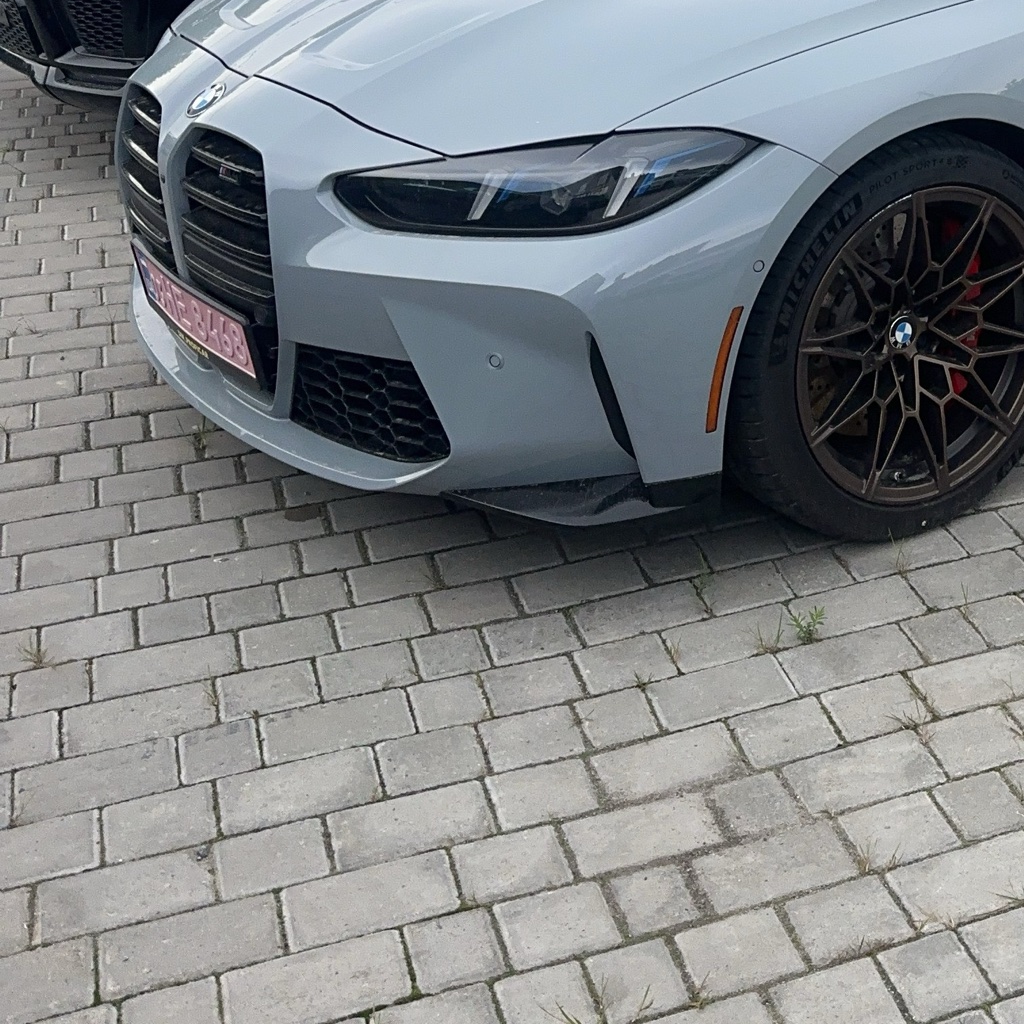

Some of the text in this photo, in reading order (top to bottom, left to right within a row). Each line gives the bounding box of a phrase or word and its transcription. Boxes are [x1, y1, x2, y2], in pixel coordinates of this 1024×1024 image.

[778, 199, 857, 327] MICHELIN
[869, 172, 899, 194] PILOT
[903, 159, 937, 176] SPORT
[191, 299, 249, 366] 8468
